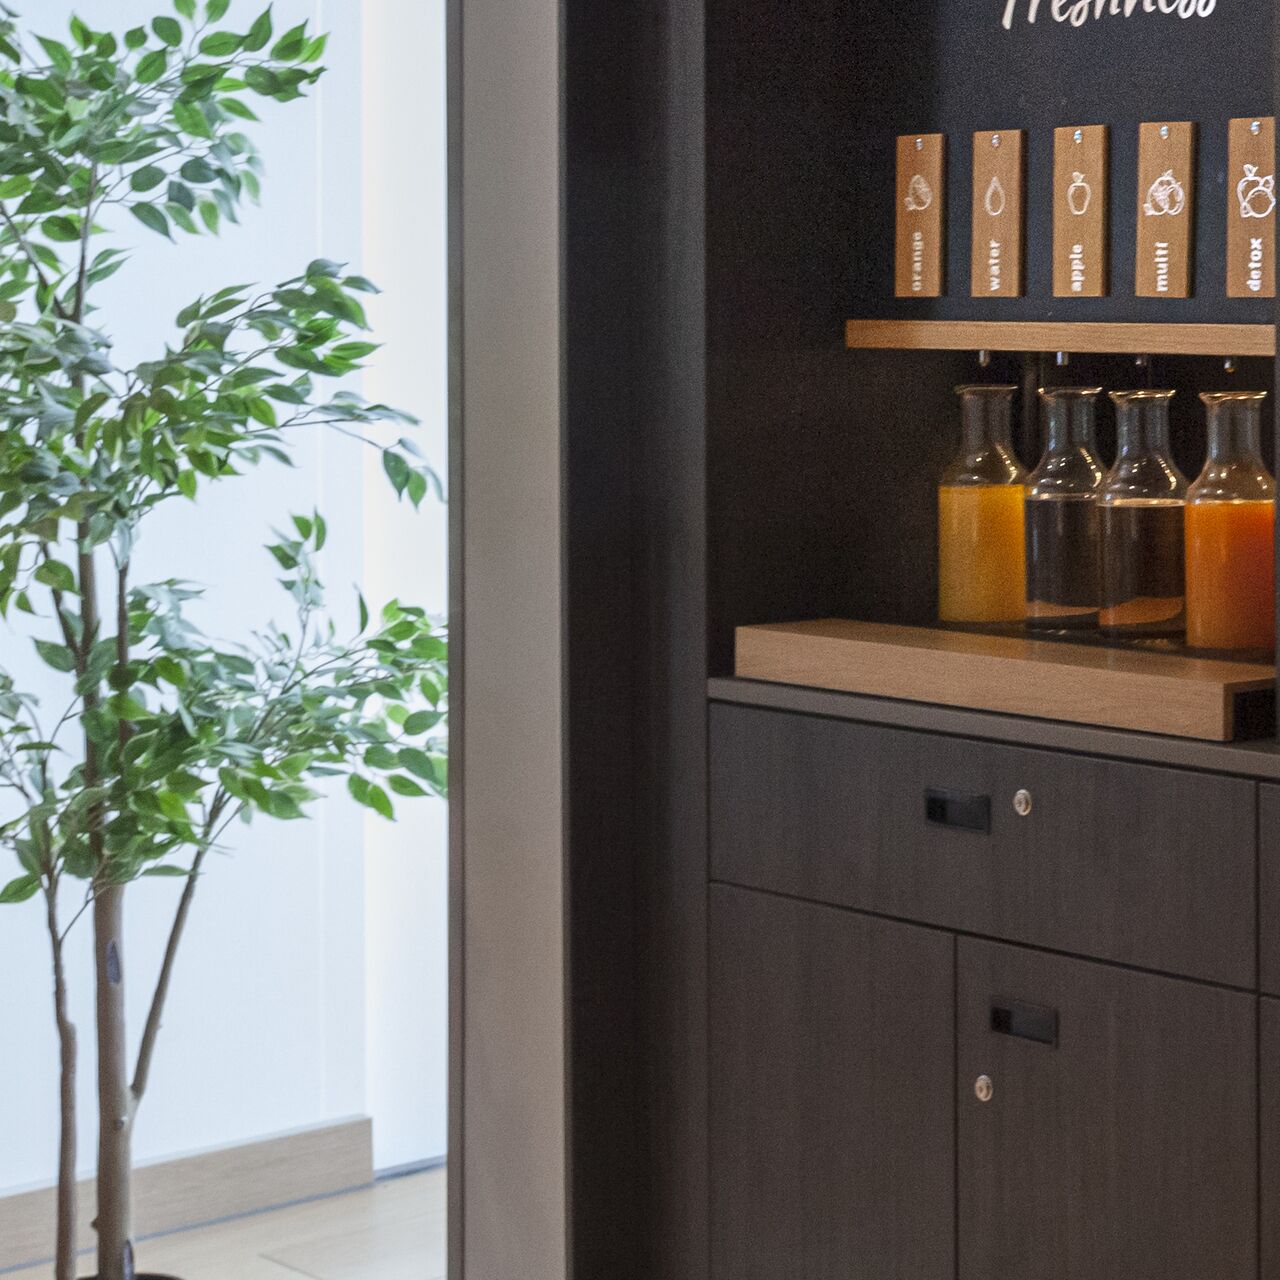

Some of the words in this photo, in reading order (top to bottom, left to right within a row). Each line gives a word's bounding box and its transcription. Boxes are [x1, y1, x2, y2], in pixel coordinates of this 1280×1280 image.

[987, 238, 1002, 292] water
[1068, 243, 1086, 293] apple
[1153, 240, 1170, 293] multi
[1245, 237, 1264, 293] detox
